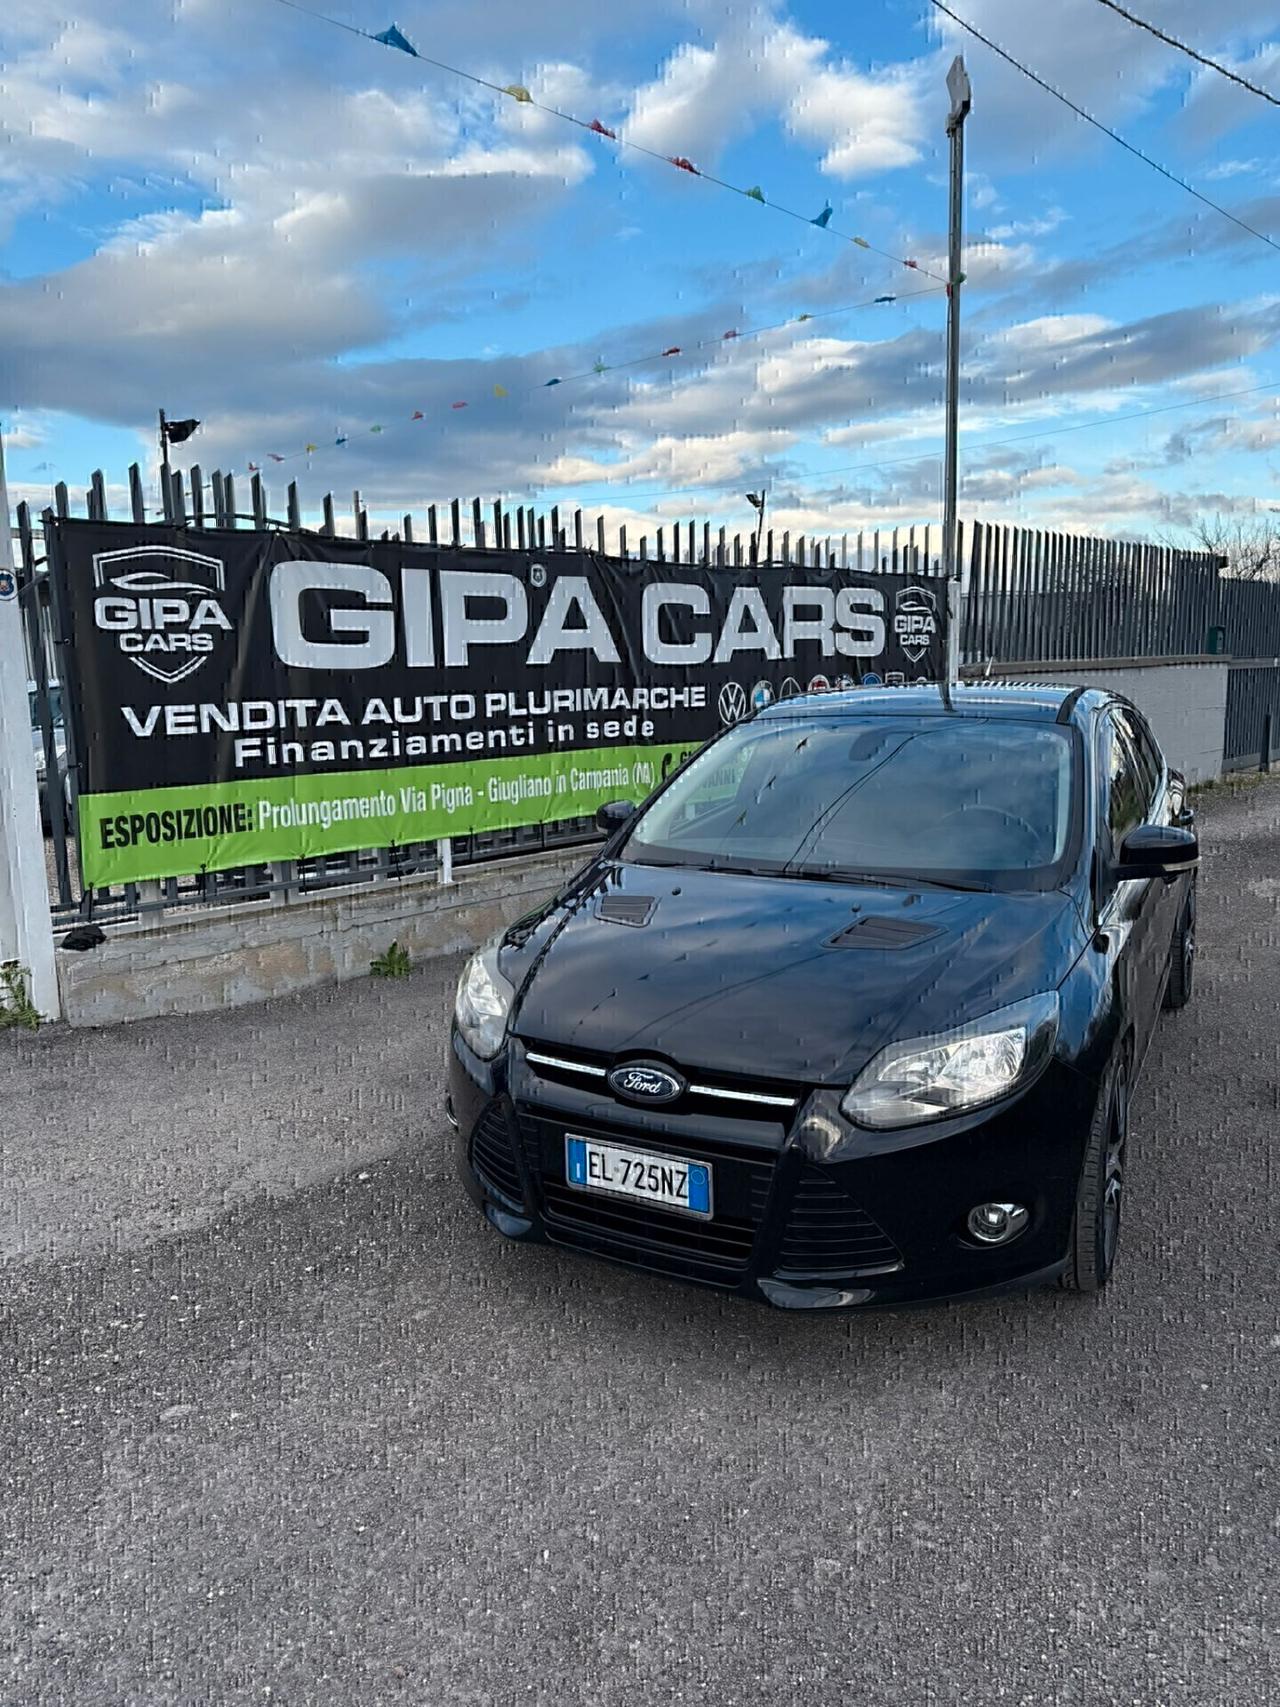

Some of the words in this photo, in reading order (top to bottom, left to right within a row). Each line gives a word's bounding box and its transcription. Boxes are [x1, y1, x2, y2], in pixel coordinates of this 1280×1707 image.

[94, 597, 233, 630] GIPA
[269, 560, 622, 669] GIPA
[642, 582, 886, 665] CARS
[894, 615, 936, 633] GIPA
[119, 633, 214, 652] CARS
[900, 634, 930, 646] CARS
[120, 699, 352, 737] VENDITA
[361, 694, 476, 725] AUTO
[485, 686, 706, 718] PLURIMARCHE
[234, 719, 534, 768] Finanziamenti
[547, 719, 575, 743] in
[586, 715, 655, 740] sede
[99, 802, 253, 850] ESPOSIZIONE:
[258, 789, 396, 830] Prolungamento
[400, 786, 427, 814] Via
[431, 781, 473, 814] Pigna
[488, 773, 551, 805] Giugliano
[555, 769, 567, 794] in
[570, 763, 630, 795] Campania
[623, 1071, 662, 1095] Ford
